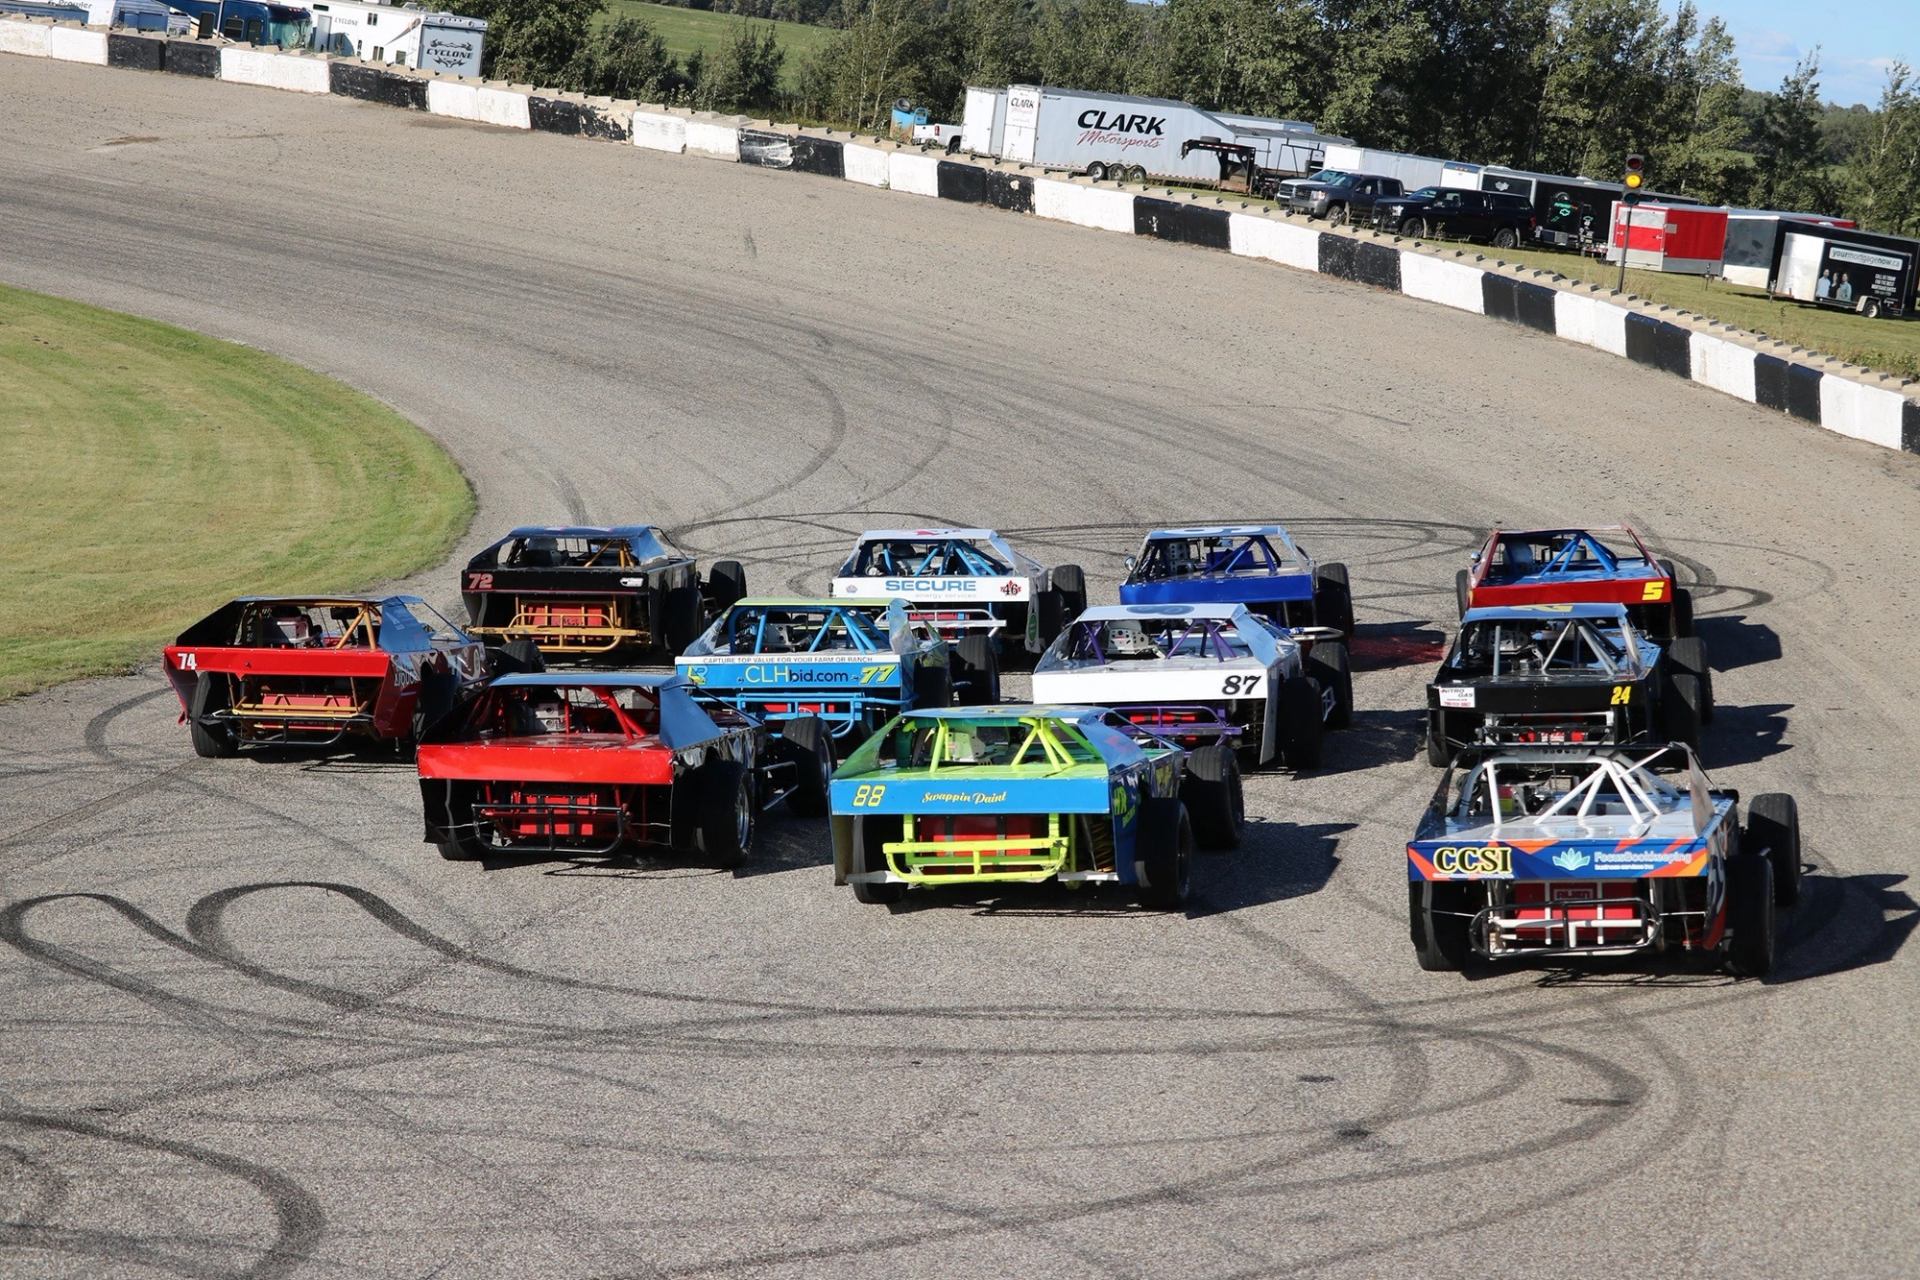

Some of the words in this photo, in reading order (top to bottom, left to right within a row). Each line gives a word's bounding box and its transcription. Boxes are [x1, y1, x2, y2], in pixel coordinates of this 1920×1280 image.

[426, 48, 473, 59] CYCLONE
[1010, 97, 1034, 109] CLARK
[1077, 109, 1167, 136] CLARK
[1076, 130, 1165, 151] Motorsports
[468, 573, 494, 589] 72
[885, 580, 977, 591] SECURE
[1641, 581, 1665, 601] 5
[177, 653, 198, 670] 74
[745, 665, 849, 683] CLHbid.com
[860, 664, 897, 684] 77
[1221, 675, 1262, 695] 87
[1610, 685, 1632, 705] 24
[853, 784, 886, 807] 88
[972, 791, 1007, 804] Paint
[1433, 847, 1512, 874] CCSI
